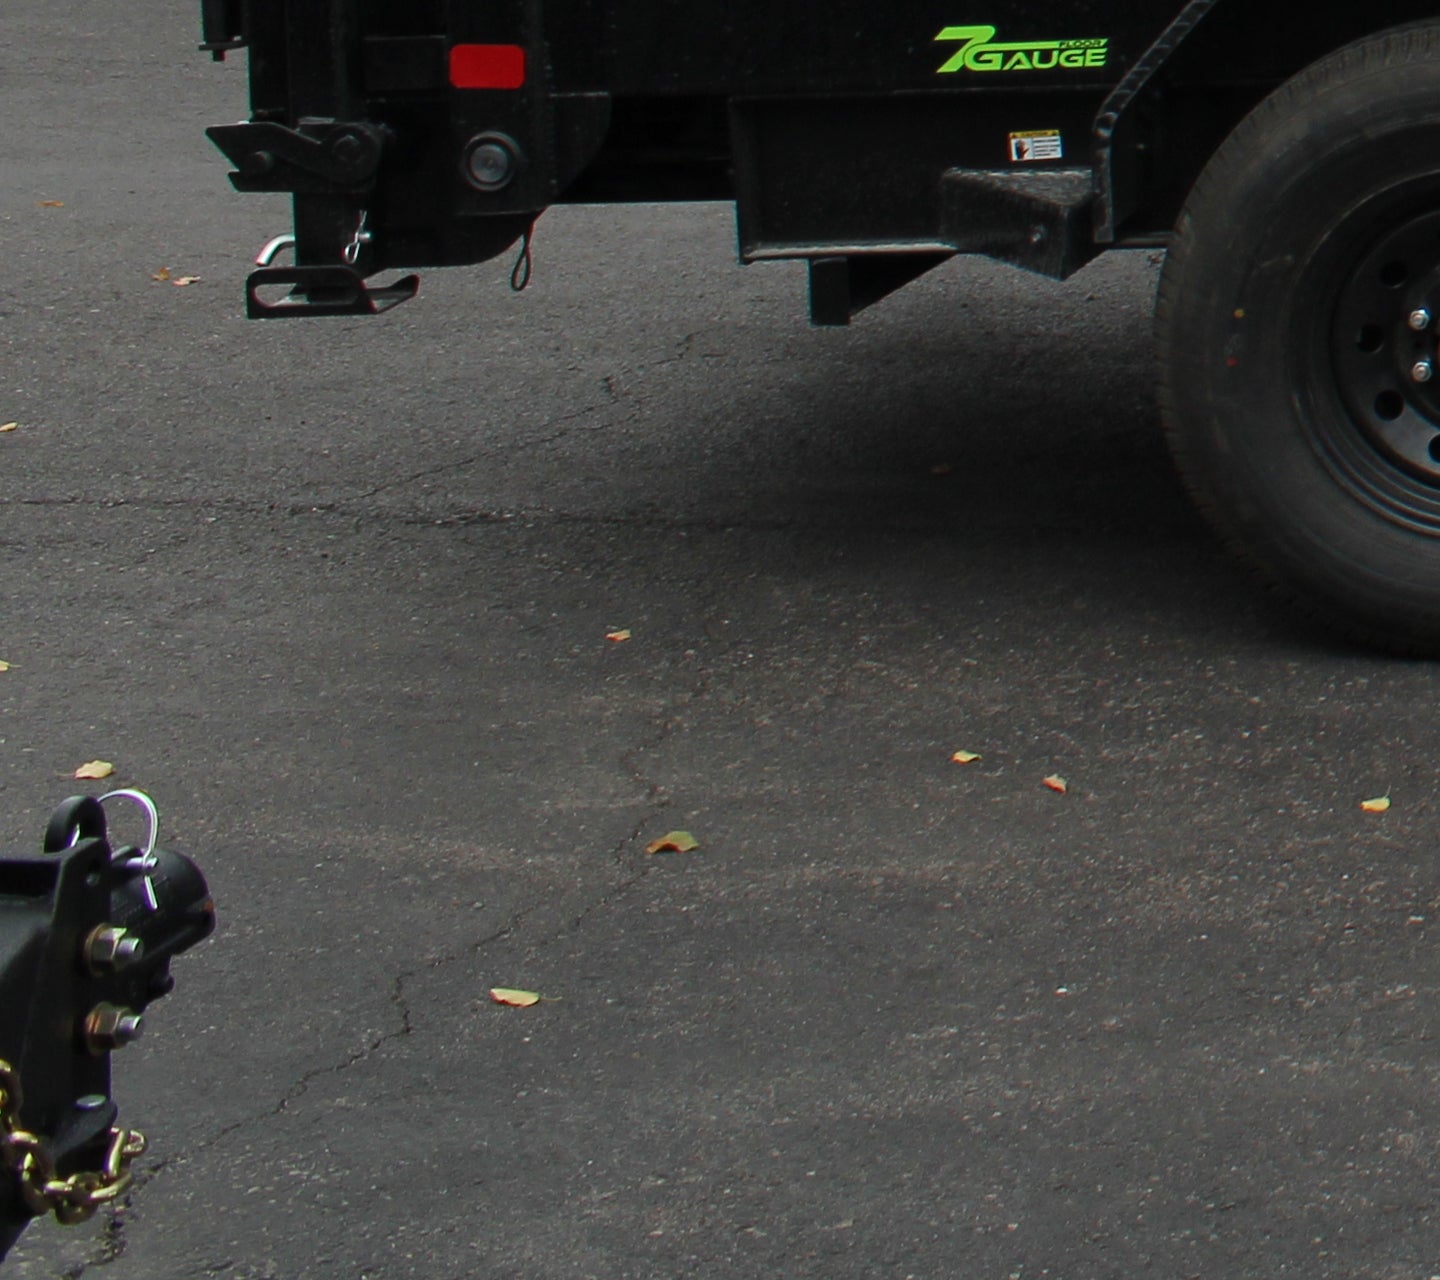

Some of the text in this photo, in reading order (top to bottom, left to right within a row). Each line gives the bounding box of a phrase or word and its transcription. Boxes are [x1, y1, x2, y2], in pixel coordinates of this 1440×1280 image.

[934, 25, 1108, 73] 7 GAUGE
[1058, 39, 1103, 49] FLOOR
